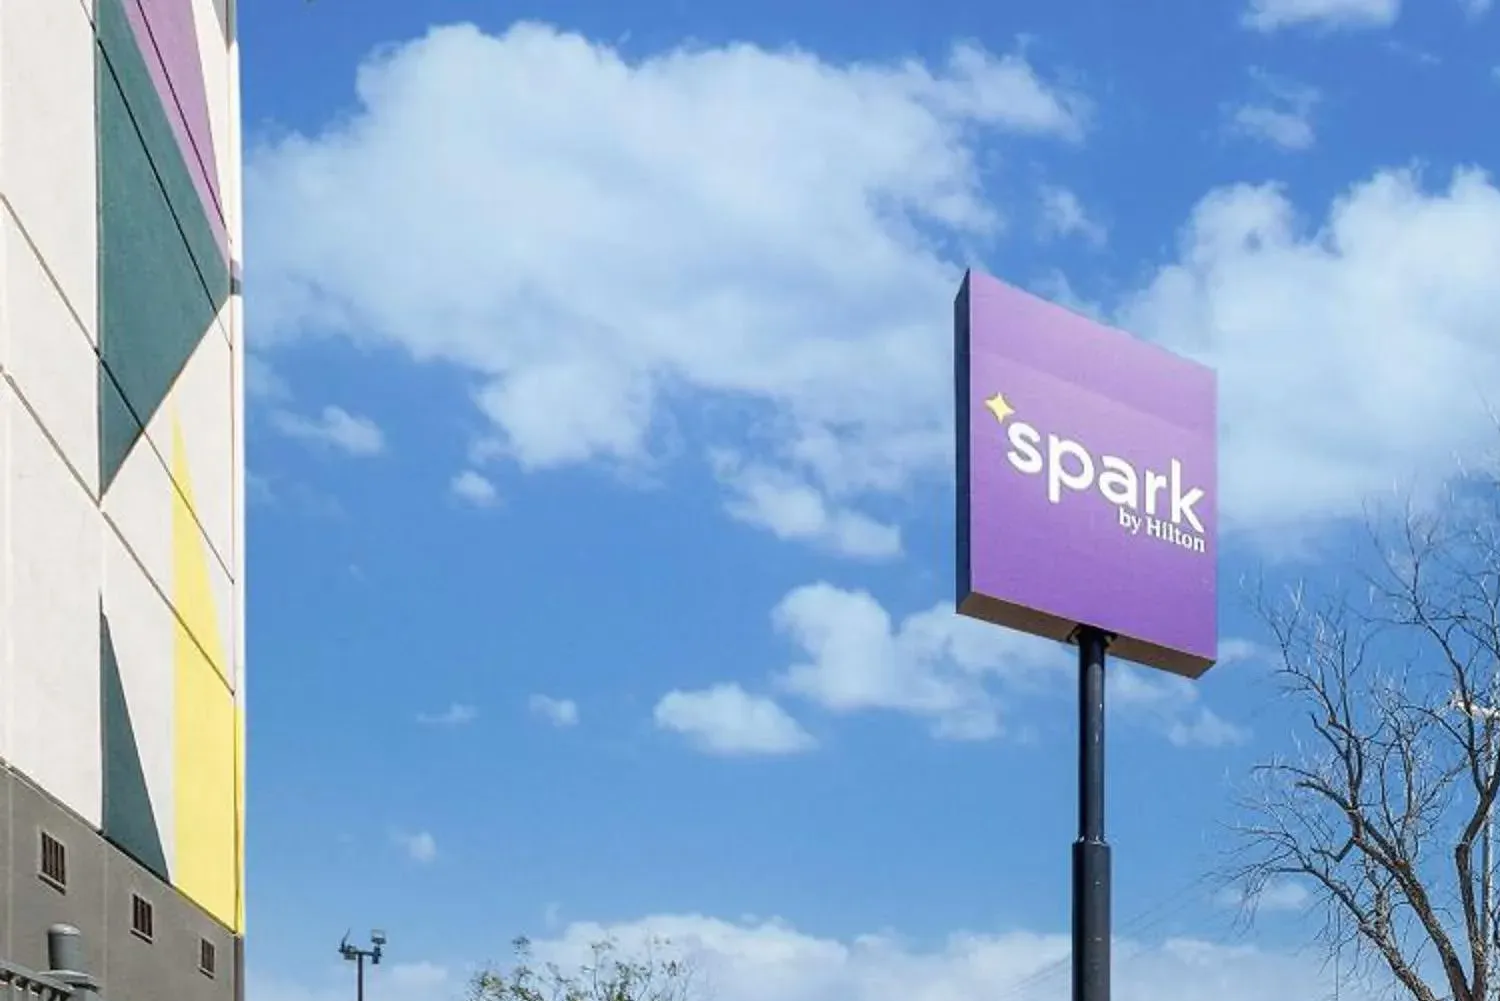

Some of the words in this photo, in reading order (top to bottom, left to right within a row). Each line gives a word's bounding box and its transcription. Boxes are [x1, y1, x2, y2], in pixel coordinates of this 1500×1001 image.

[1007, 421, 1205, 533] spark
[1119, 505, 1142, 535] by
[1145, 515, 1205, 553] Hilton
